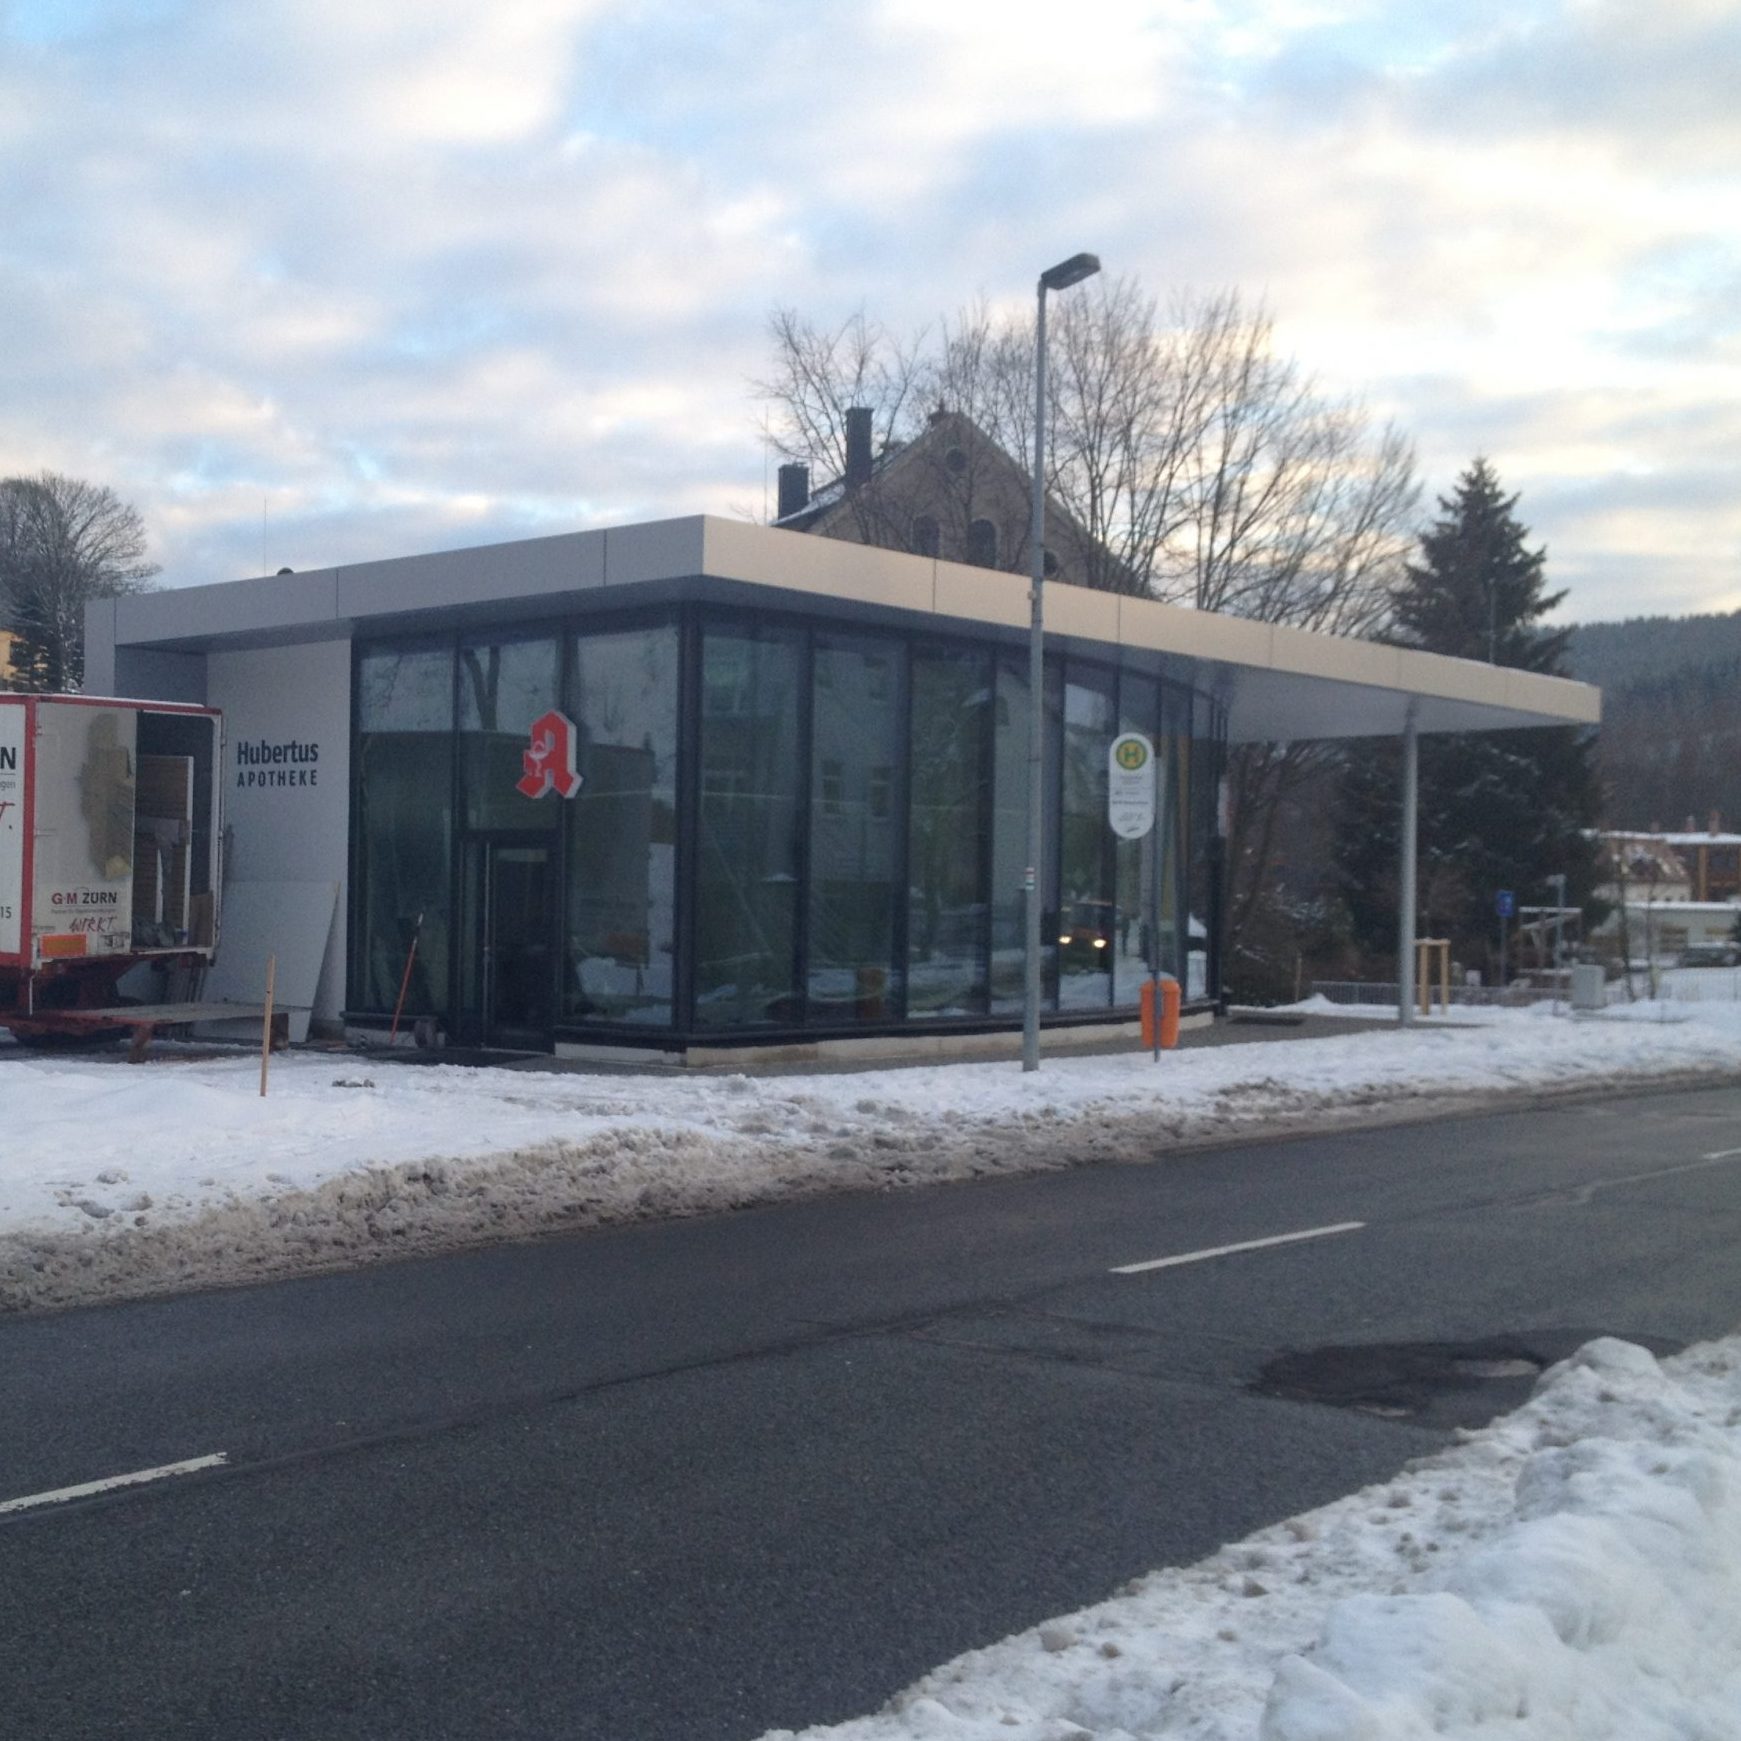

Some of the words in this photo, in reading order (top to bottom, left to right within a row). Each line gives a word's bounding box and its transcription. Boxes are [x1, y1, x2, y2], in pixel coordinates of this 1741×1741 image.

[237, 740, 319, 765] Hubertus
[1124, 745, 1138, 763] H
[237, 769, 317, 787] APOTHEKE
